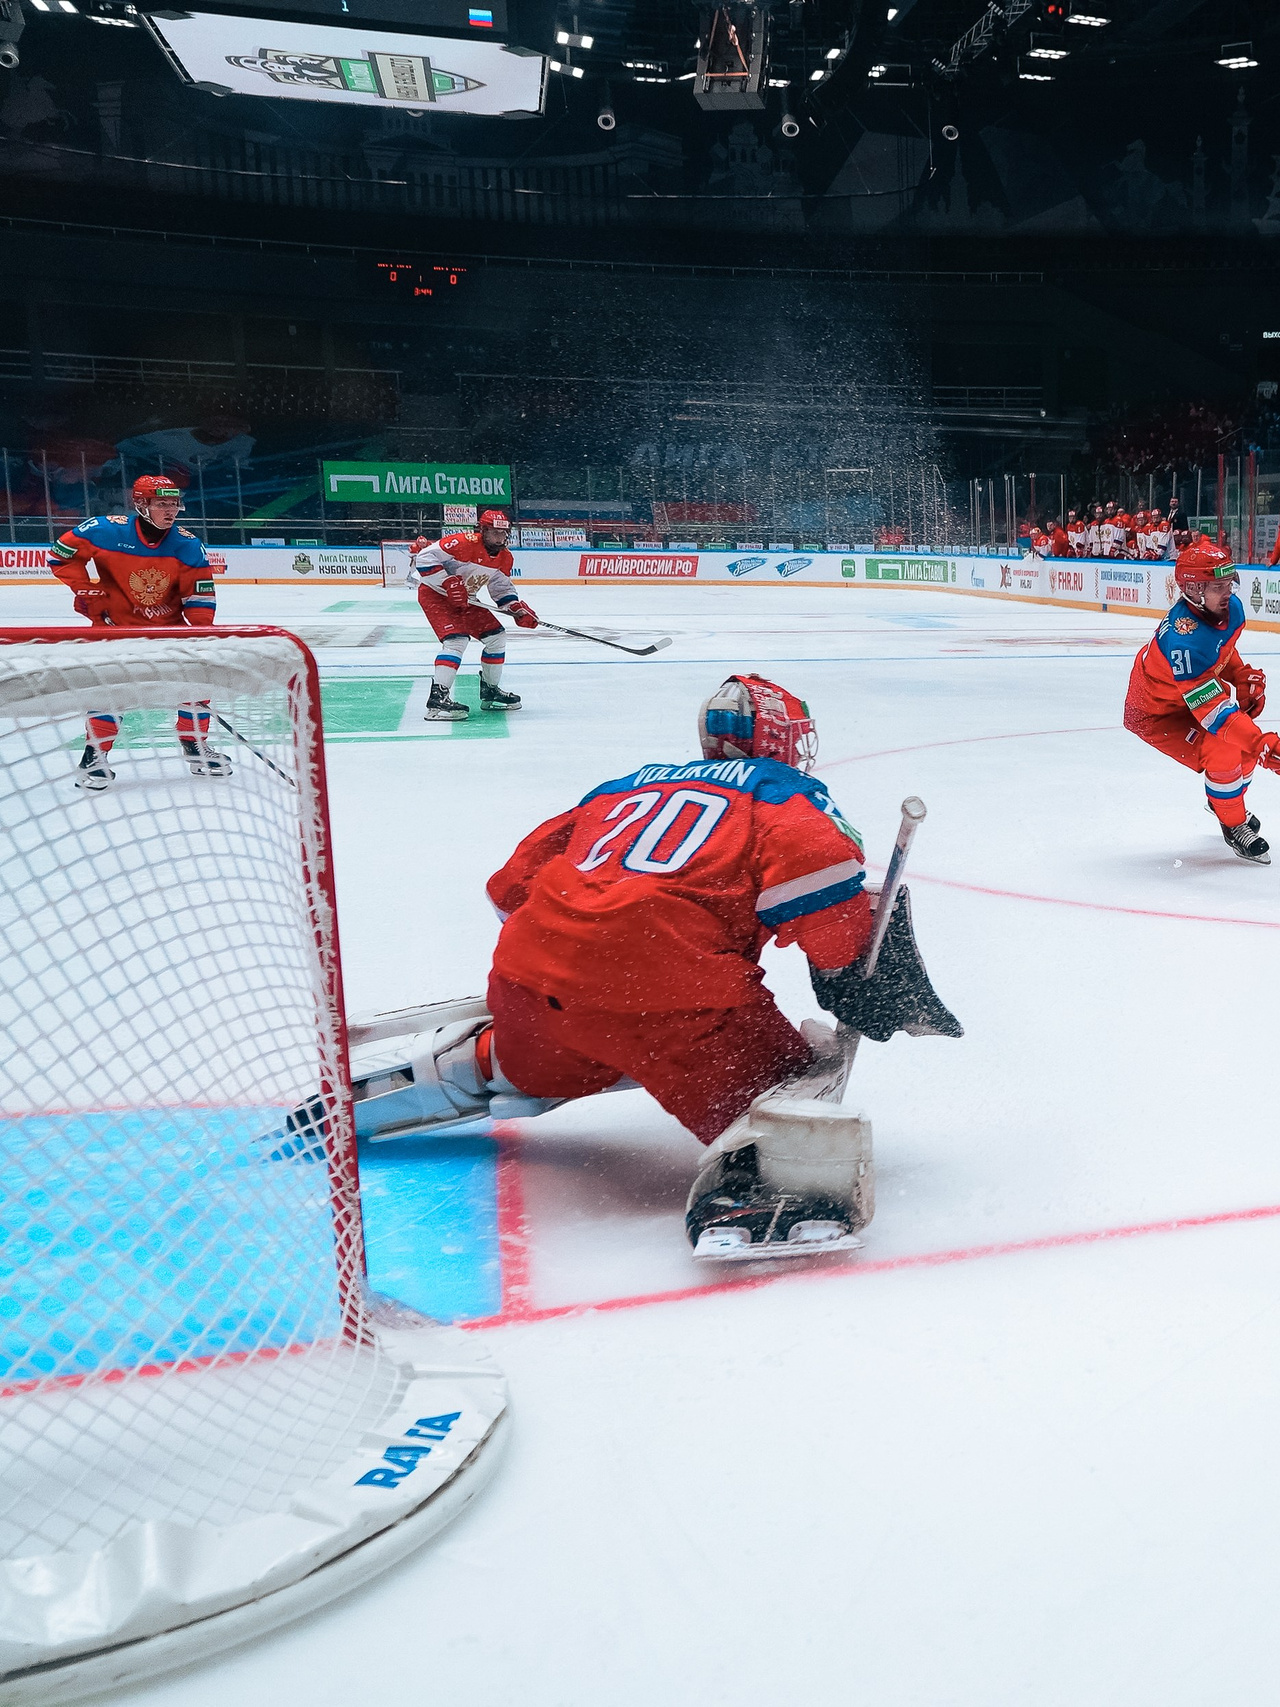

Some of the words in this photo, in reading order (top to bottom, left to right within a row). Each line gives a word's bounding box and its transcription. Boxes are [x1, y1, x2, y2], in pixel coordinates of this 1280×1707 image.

[384, 471, 432, 494] ЛИГА
[434, 472, 505, 496] СТАВОК
[338, 553, 368, 564] СТАВОК
[585, 556, 693, 575] ИГРАЙВРОССИИ.РФ
[318, 565, 348, 574] КУБОК
[1058, 572, 1083, 592] FHR.RU
[1170, 649, 1192, 676] 31
[1200, 687, 1221, 703] СТАВОК
[576, 789, 731, 874] 20
